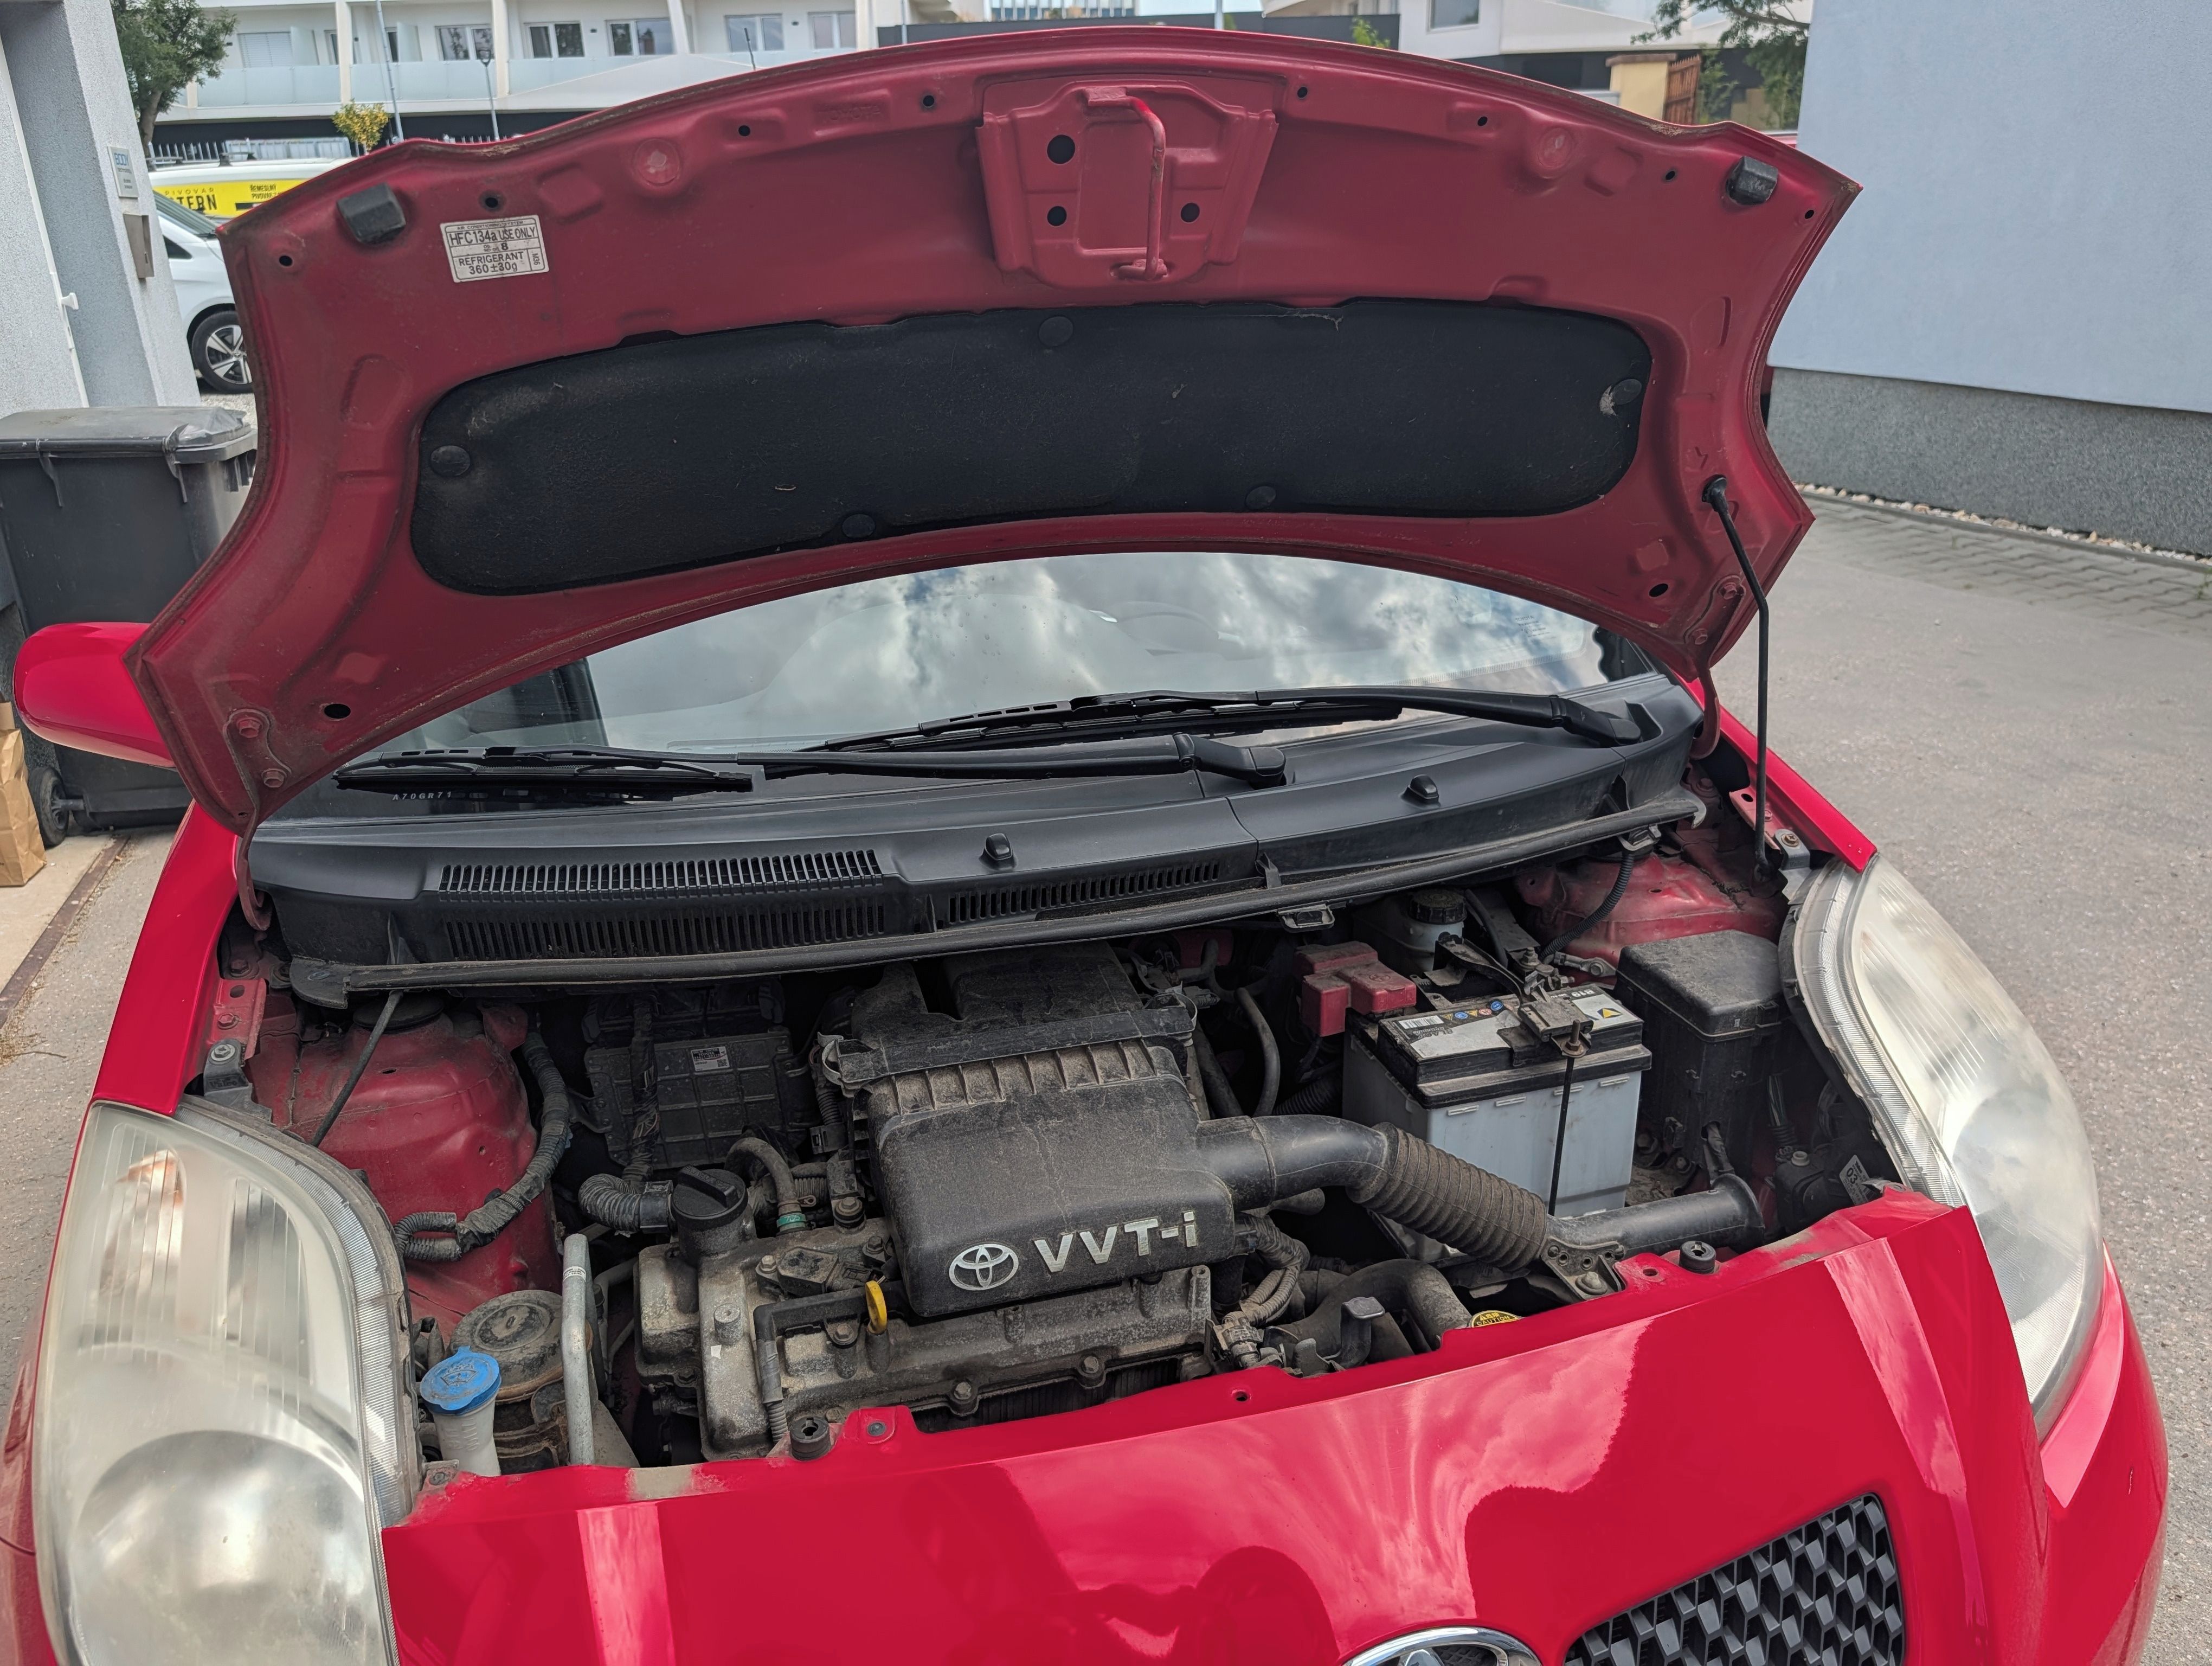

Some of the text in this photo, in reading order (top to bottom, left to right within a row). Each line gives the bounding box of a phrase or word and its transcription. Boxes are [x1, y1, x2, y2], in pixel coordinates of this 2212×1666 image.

[170, 194, 217, 210] TERN
[467, 222, 501, 230] CONDITIONING
[499, 229, 515, 241] USE
[515, 227, 535, 238] ONLY
[501, 242, 509, 251] 8
[459, 251, 524, 266] REFRIGERANT
[1571, 988, 1596, 998] B19
[1415, 1029, 1454, 1040] BLACK
[1846, 1167, 1858, 1184] 03
[1033, 1210, 1198, 1273] VVT-i
[1476, 1315, 1510, 1326] CAUTION
